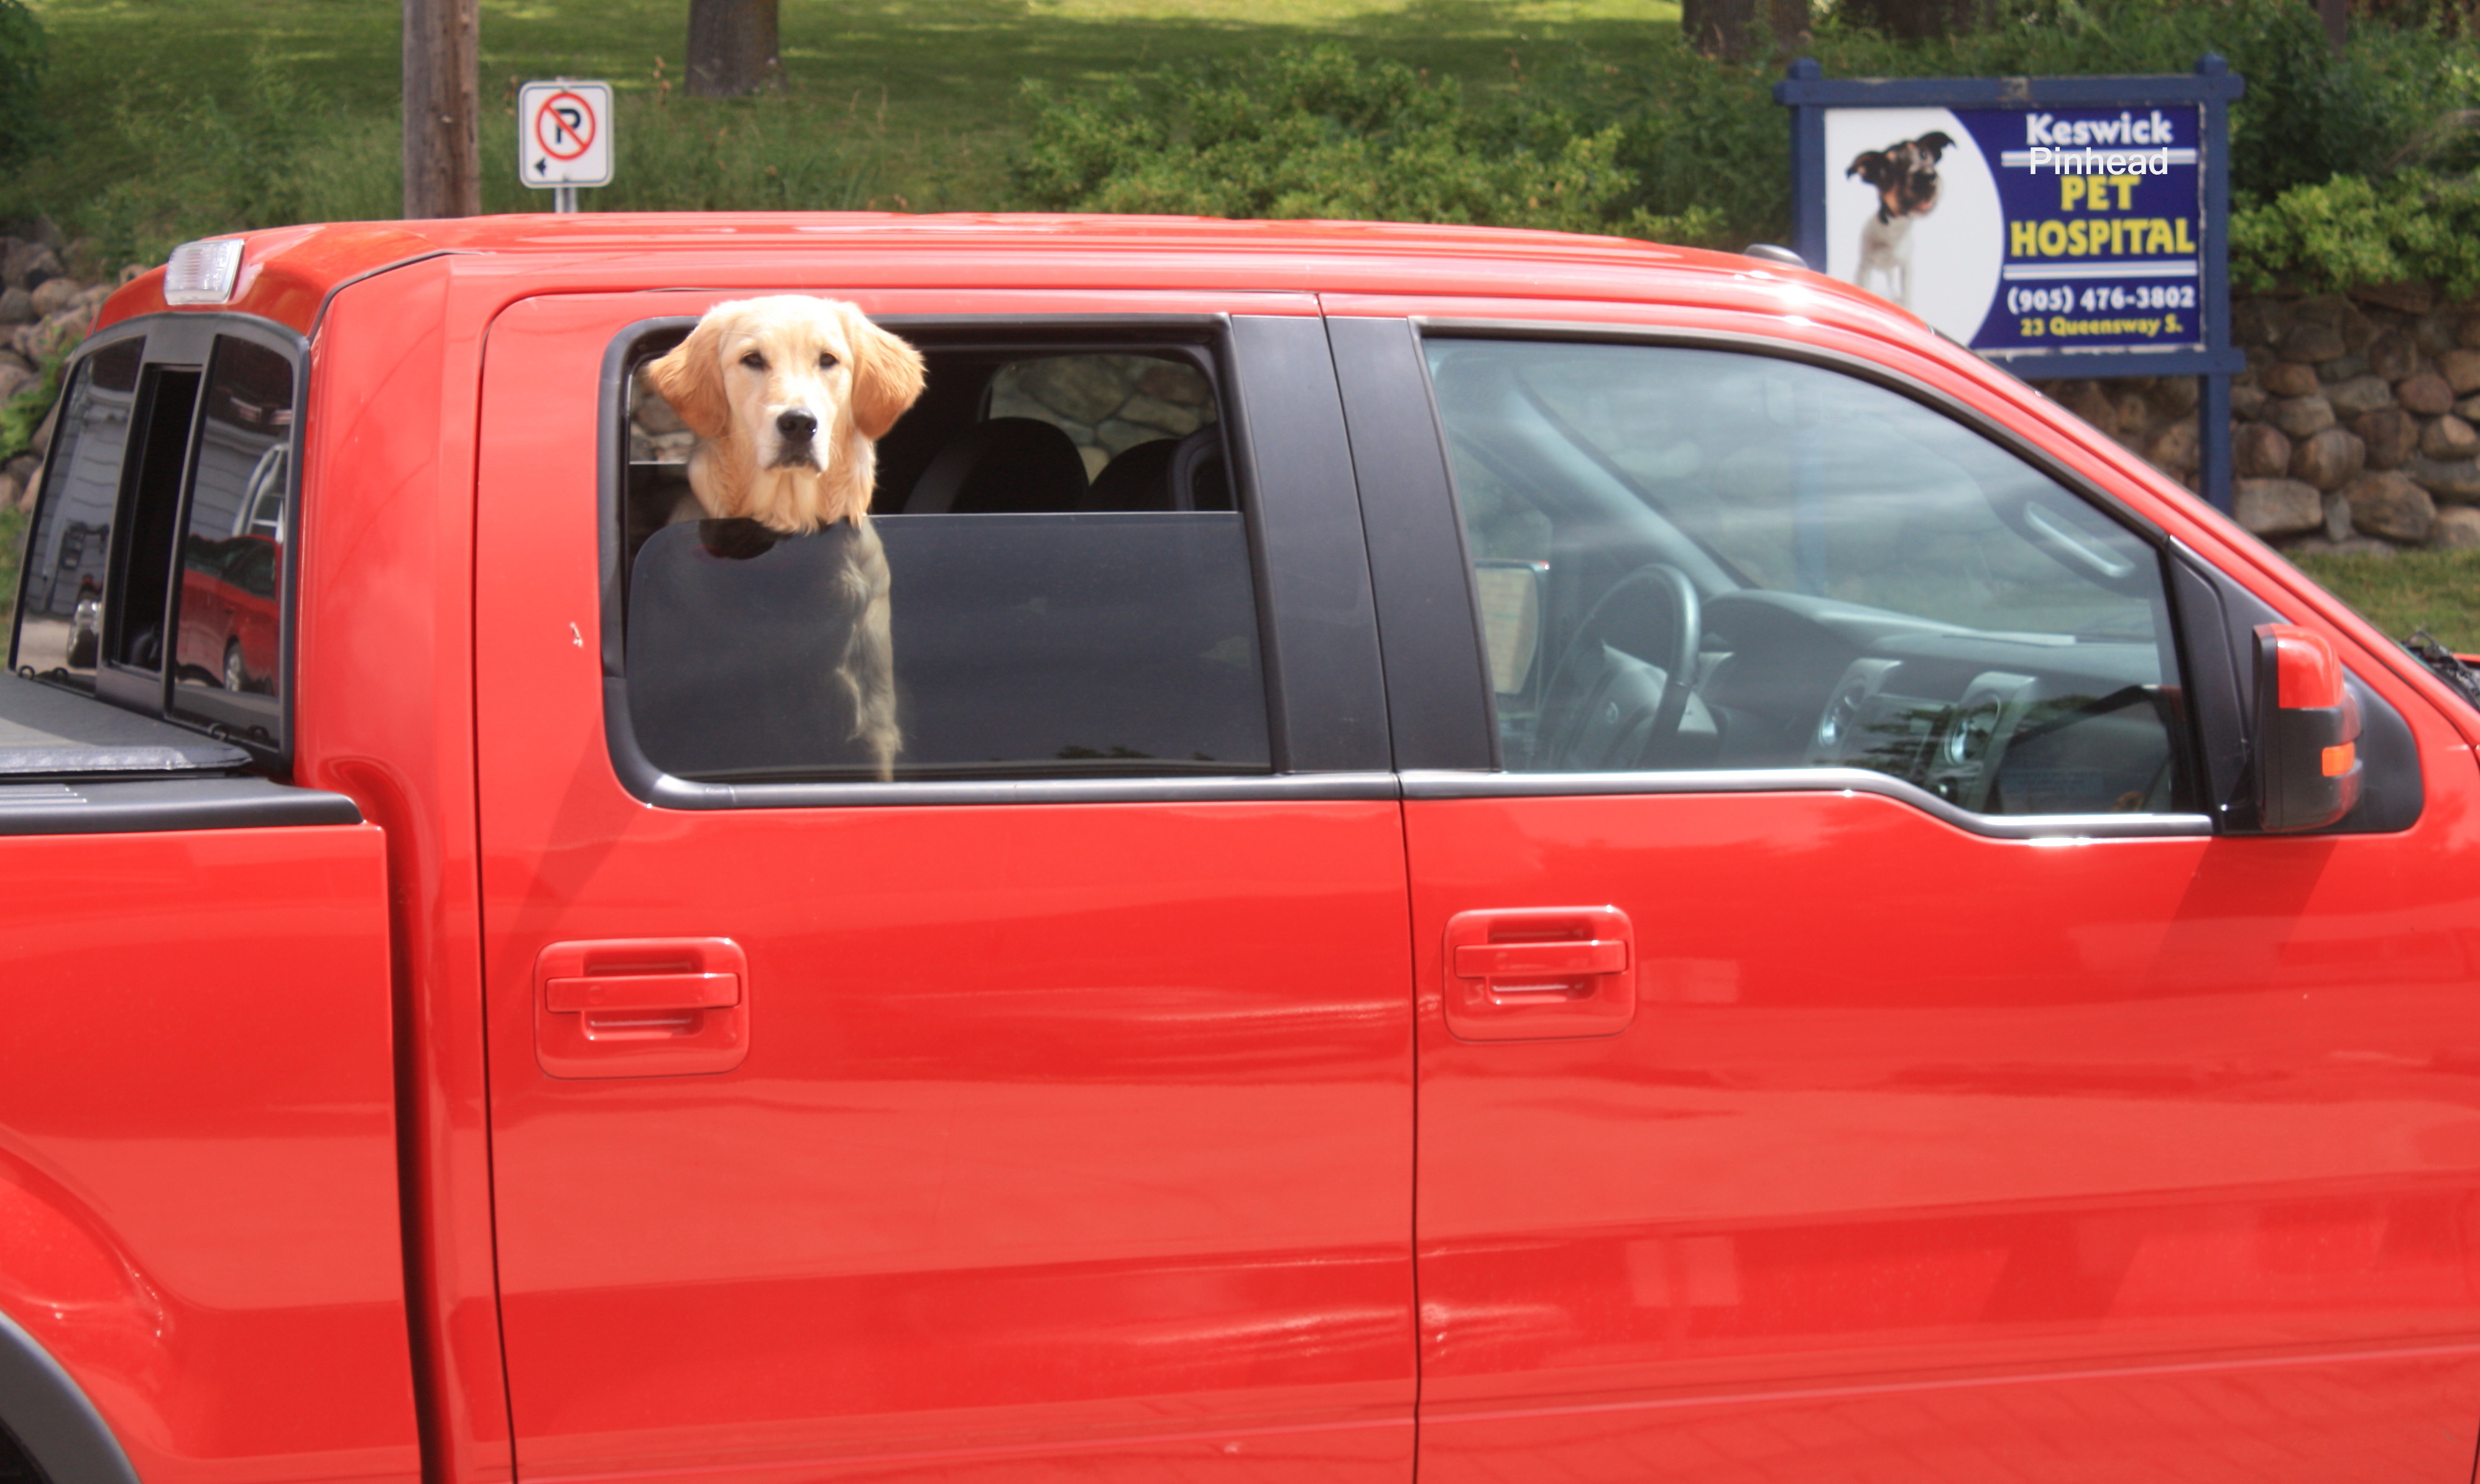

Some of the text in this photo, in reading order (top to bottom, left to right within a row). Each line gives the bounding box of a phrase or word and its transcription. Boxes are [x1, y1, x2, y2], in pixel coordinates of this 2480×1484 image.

[2026, 110, 2173, 145] Keswick
[2060, 174, 2141, 211] PET
[2010, 218, 2197, 257] HOSPITAL
[2007, 285, 2195, 315] (905) 476-3802
[2020, 313, 2183, 338] 23 Queensway S.
